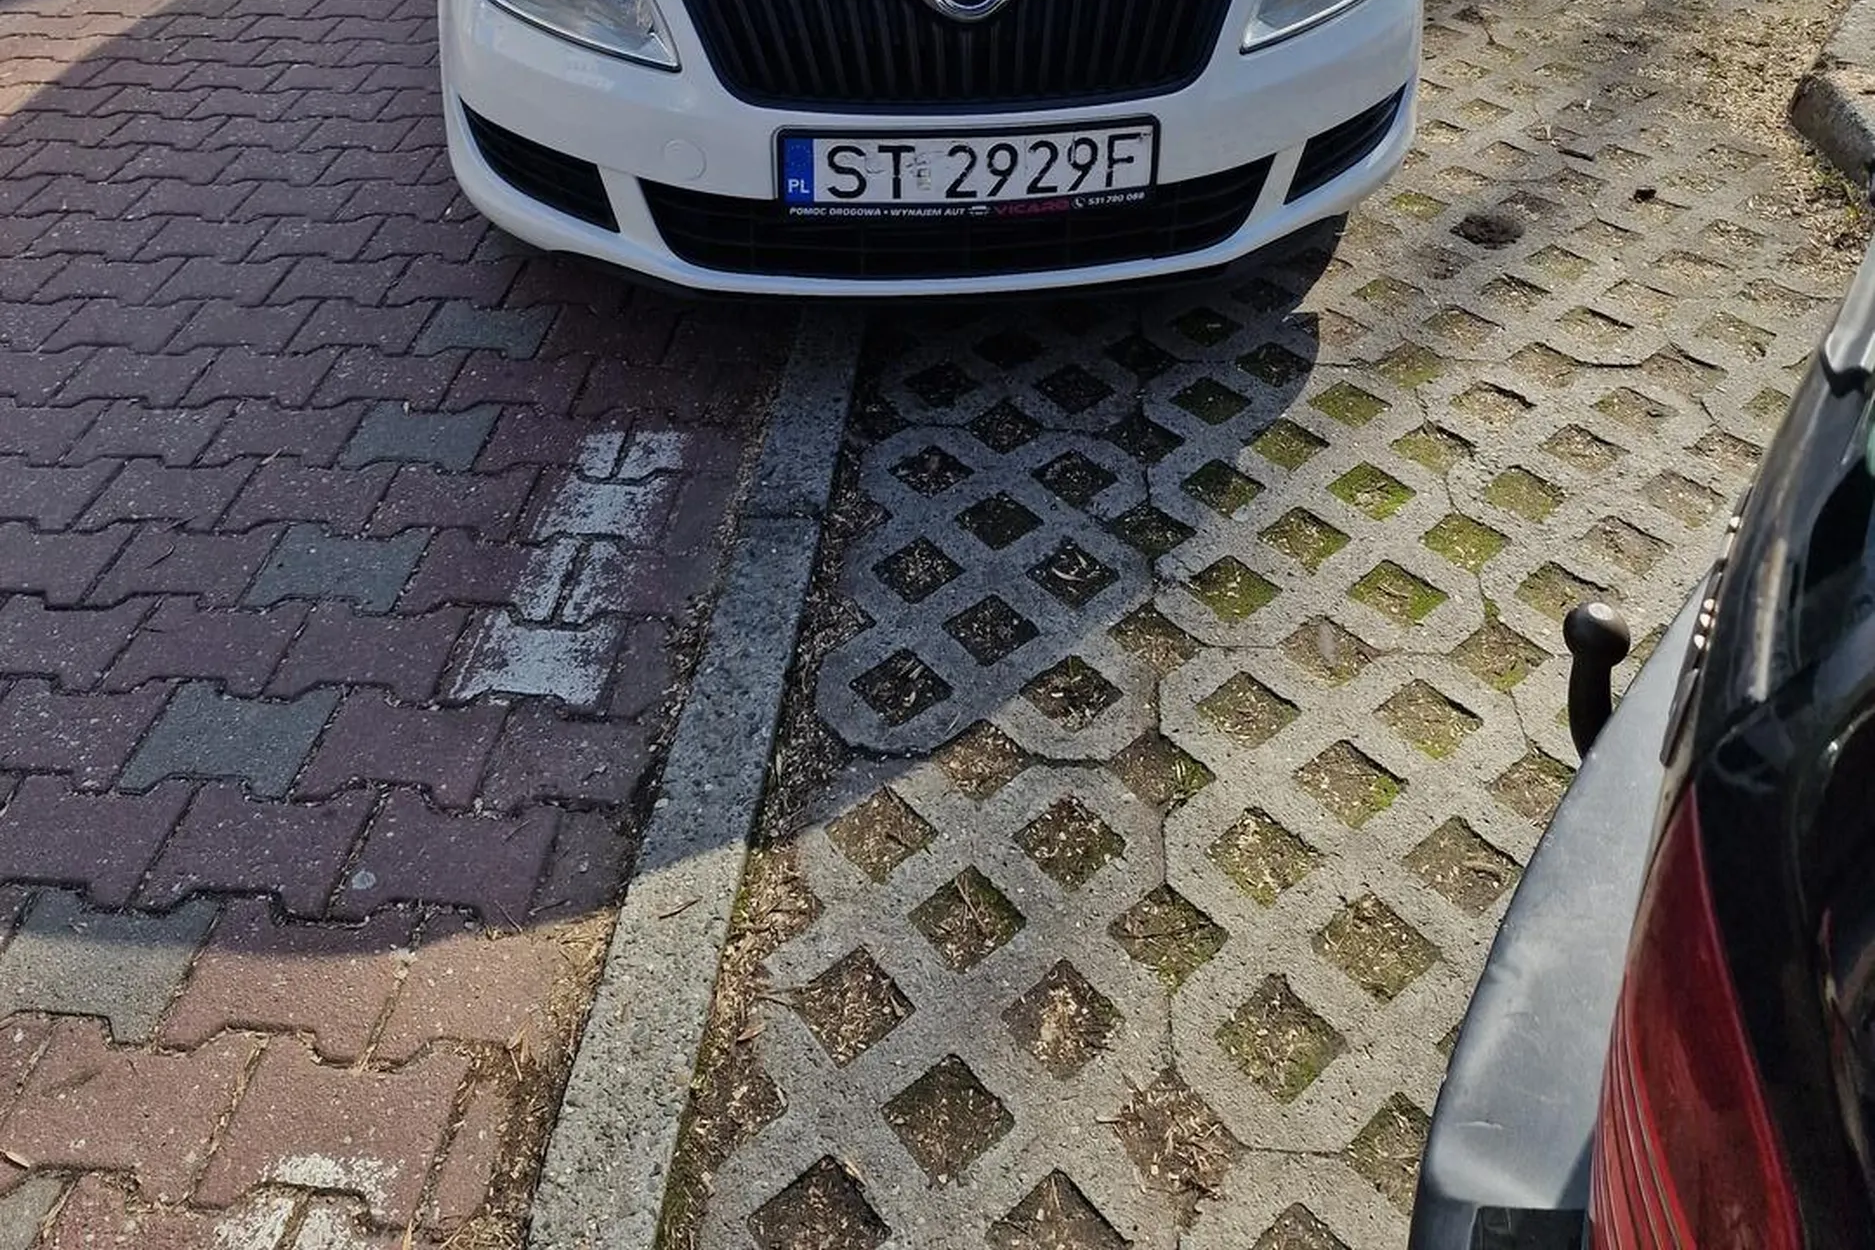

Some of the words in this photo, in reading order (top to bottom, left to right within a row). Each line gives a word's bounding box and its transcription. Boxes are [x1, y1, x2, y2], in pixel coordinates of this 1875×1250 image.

[826, 145, 916, 200] ST
[945, 132, 1144, 199] 2929F
[787, 179, 810, 194] PL
[789, 207, 828, 216] POMOC
[829, 207, 882, 216] DROGOWA
[890, 207, 942, 217] WYNAJEM
[944, 207, 966, 216] AUT
